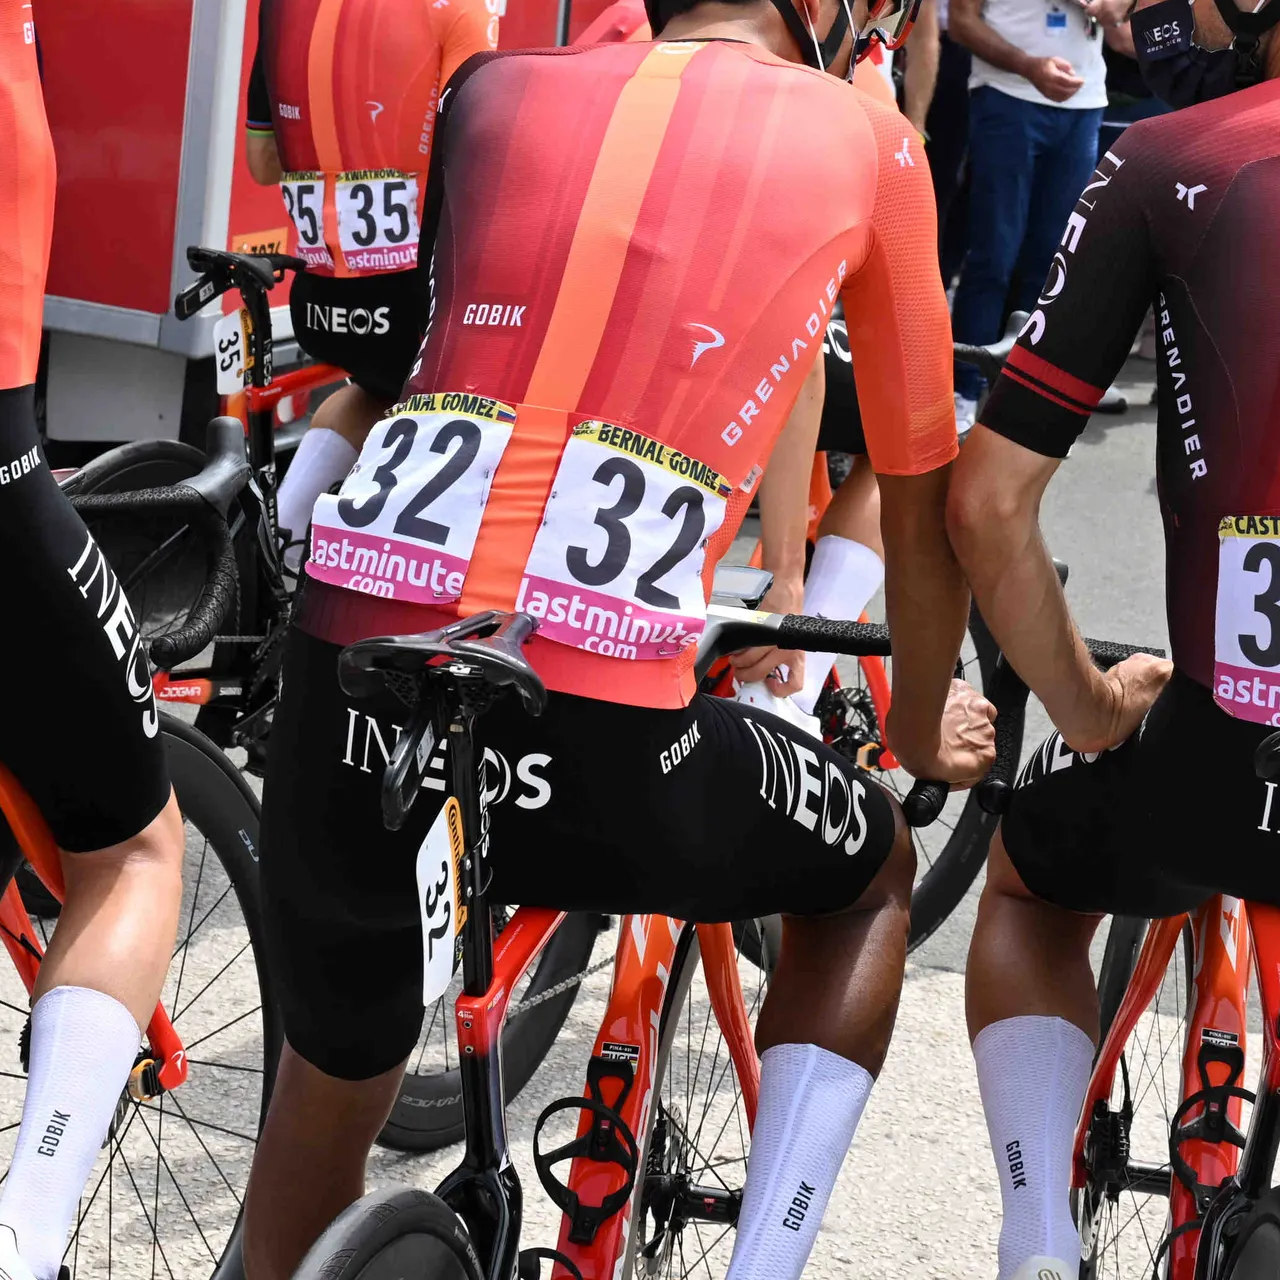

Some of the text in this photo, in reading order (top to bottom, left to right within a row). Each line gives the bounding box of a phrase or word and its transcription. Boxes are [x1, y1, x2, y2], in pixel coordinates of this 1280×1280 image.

[1144, 21, 1180, 45] INEOS
[279, 103, 301, 119] GOBIK
[350, 182, 410, 246] 35
[1017, 150, 1126, 346] INEOS
[306, 302, 390, 335] INEOS
[463, 304, 526, 327] GOBIK
[219, 331, 240, 372] 35
[721, 259, 847, 447] GRENADIER
[442, 393, 496, 418] GOMEZ
[1159, 292, 1208, 480] GRENADIER
[338, 418, 482, 546] 32
[597, 423, 664, 465] BERNAL
[669, 452, 720, 490] GOMEZ
[566, 457, 706, 610] 32
[516, 578, 700, 648] lastminute
[578, 635, 637, 660] .com
[661, 720, 701, 775] GOBIK
[743, 717, 868, 856] INEOS
[426, 860, 450, 963] 32
[38, 1109, 71, 1157] GOBIK
[1006, 1140, 1027, 1190] GOBIK
[783, 1180, 816, 1231] GOBIK
